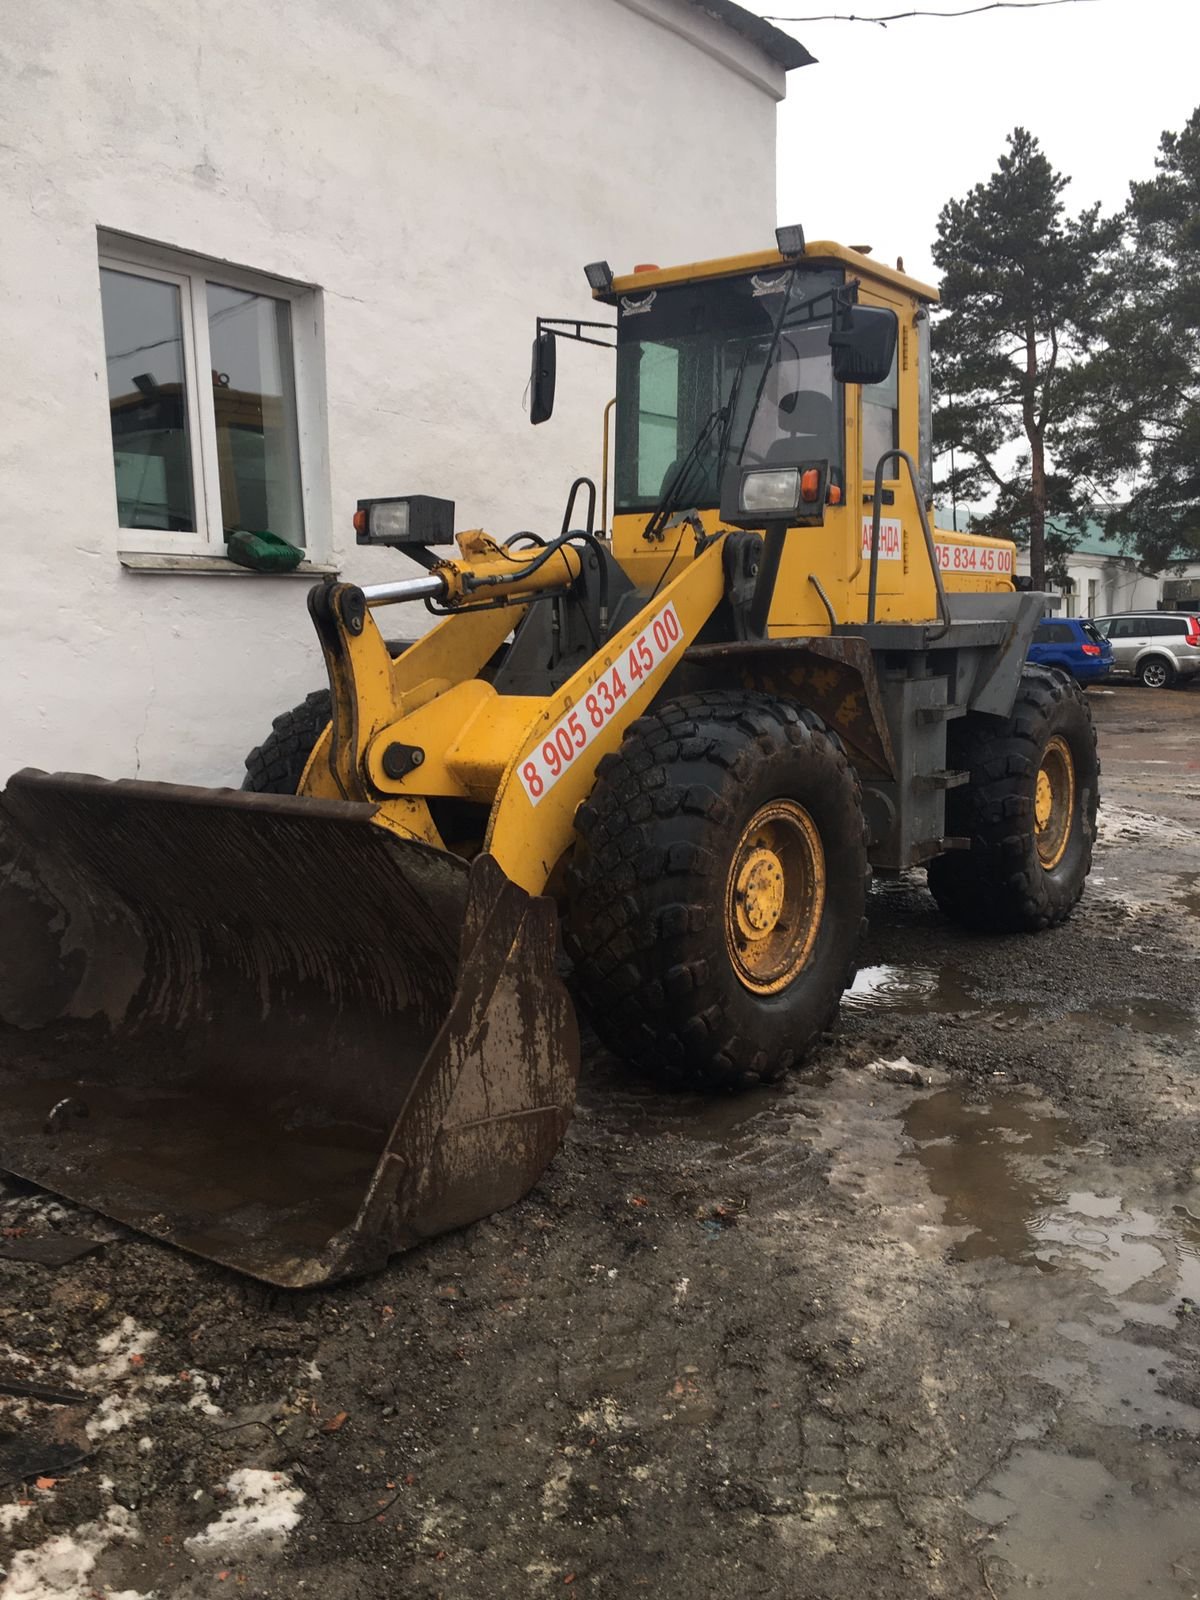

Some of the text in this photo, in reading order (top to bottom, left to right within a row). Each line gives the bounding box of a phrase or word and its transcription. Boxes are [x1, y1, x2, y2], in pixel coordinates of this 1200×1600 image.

[862, 524, 899, 557] АНДА
[953, 547, 976, 569] 834
[980, 549, 994, 570] 45
[997, 551, 1010, 571] 00
[523, 609, 679, 797] 8 905 834 45 00
